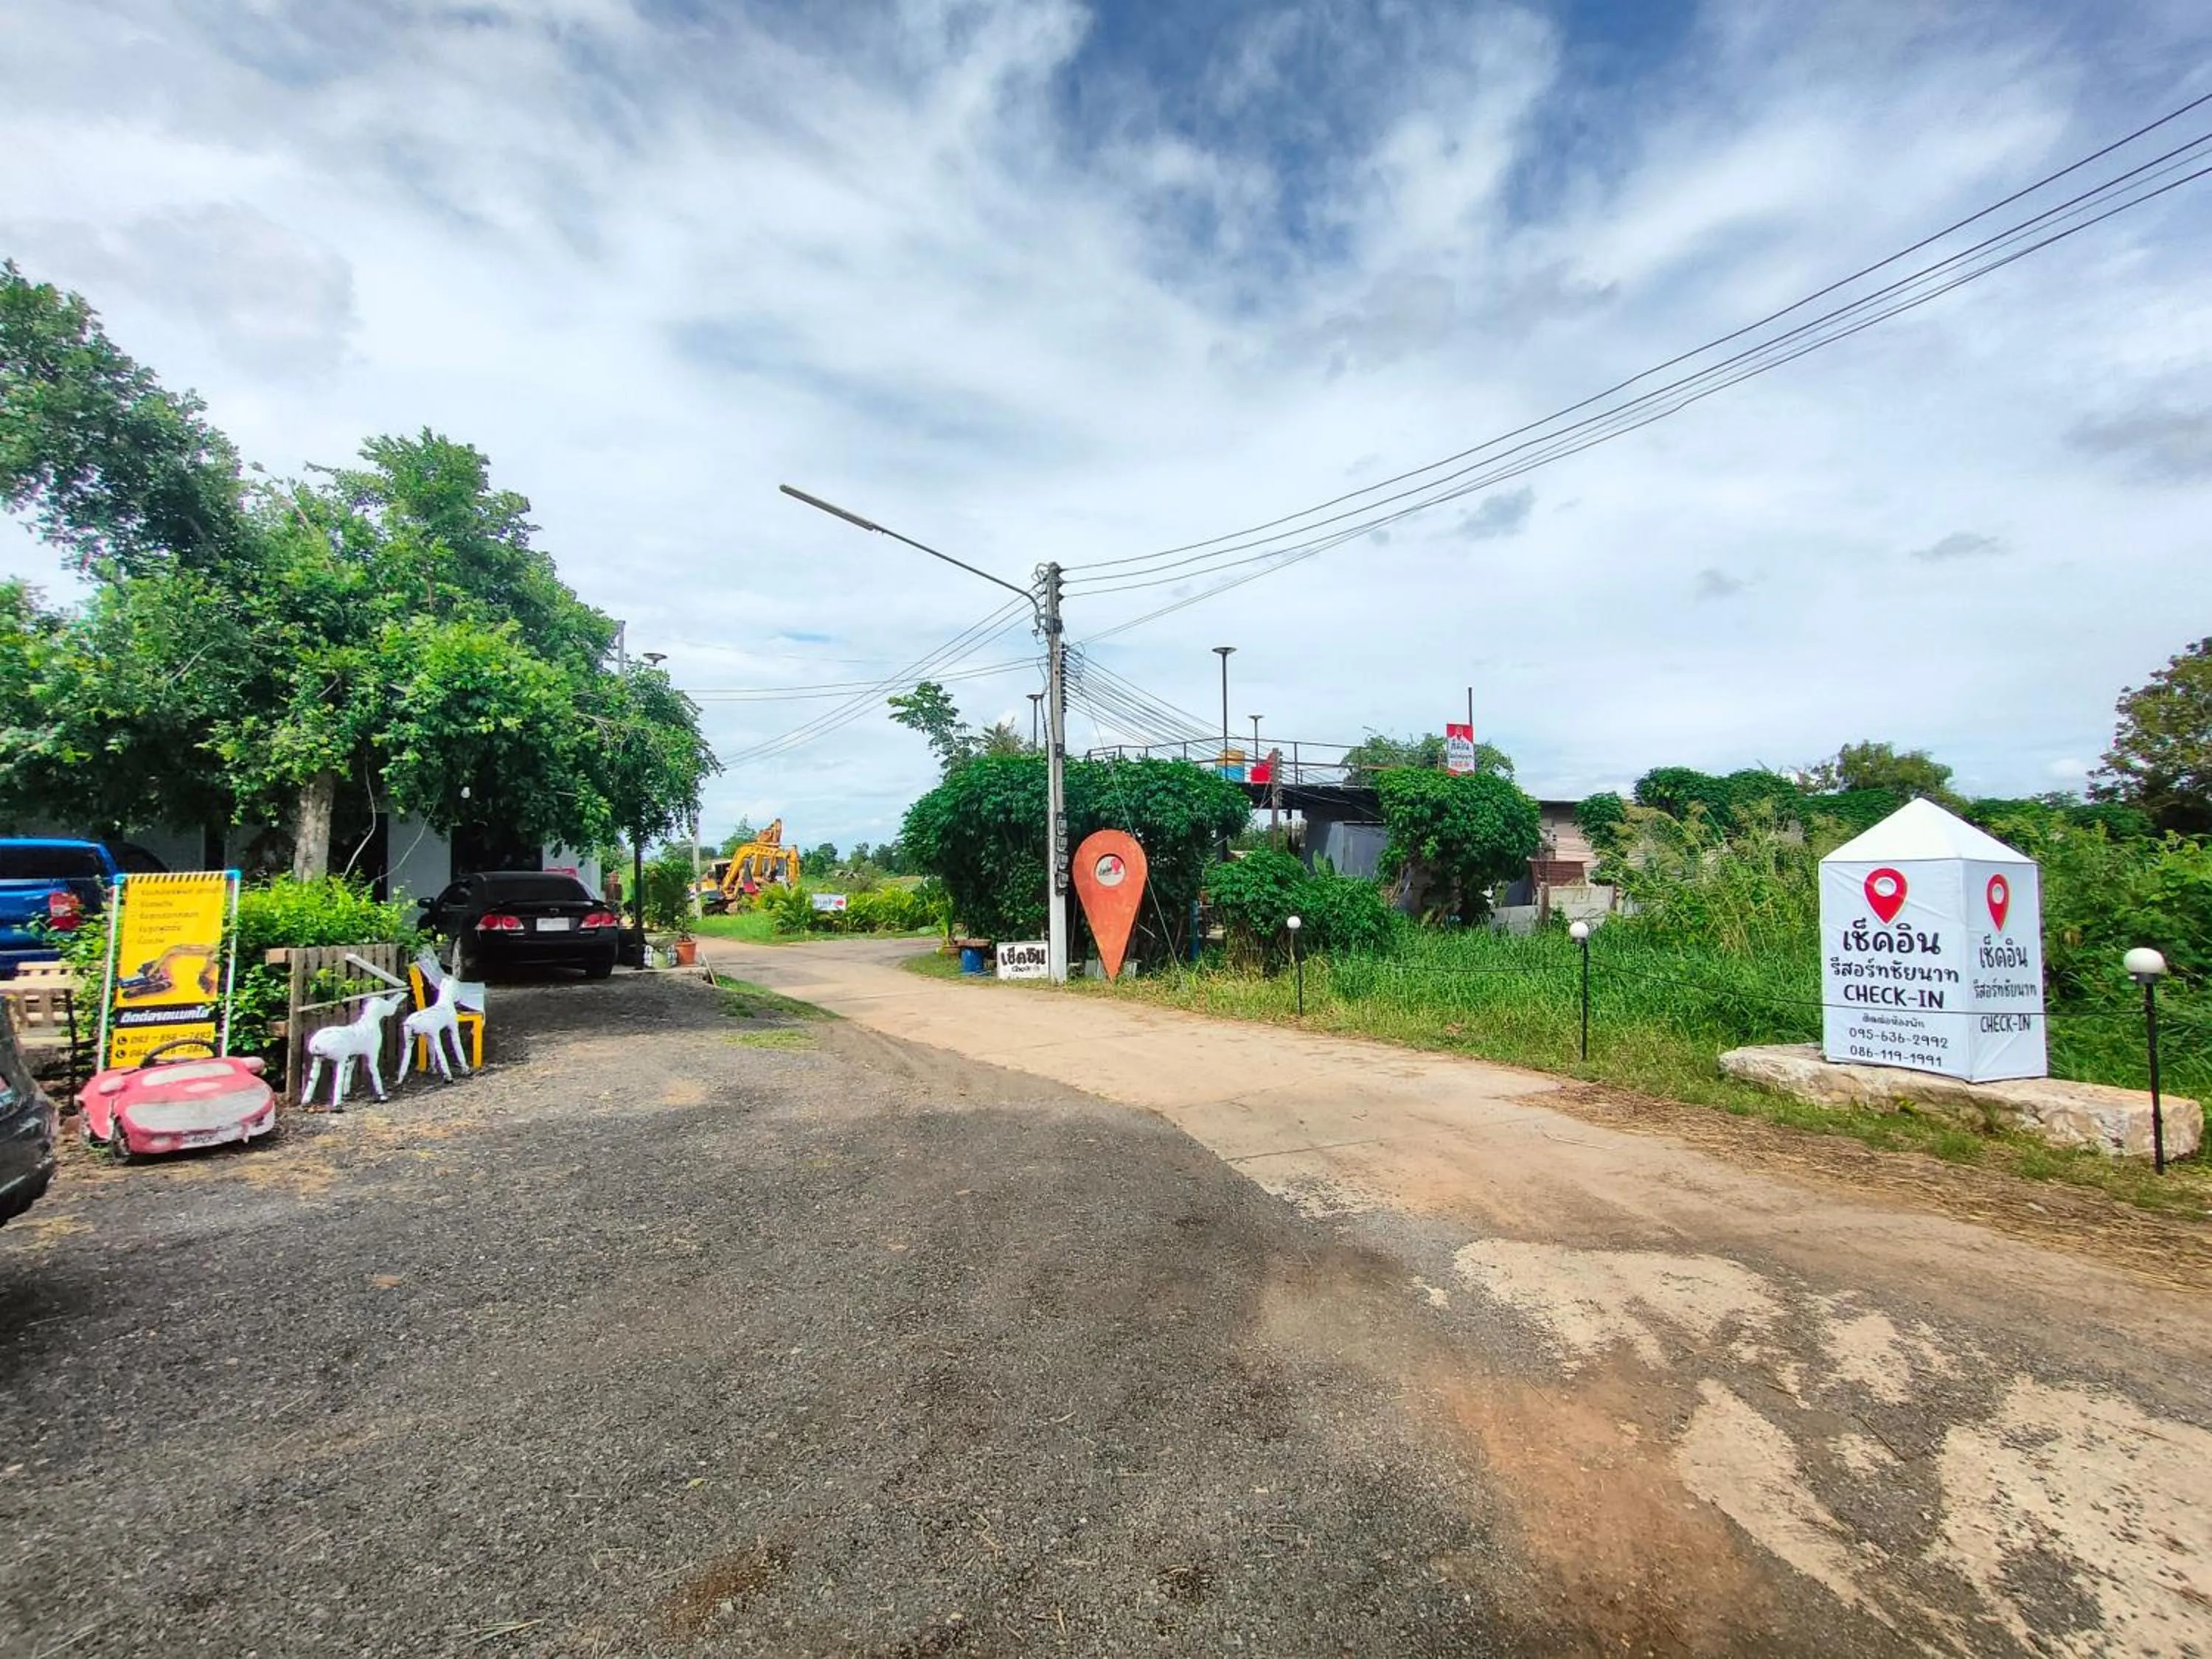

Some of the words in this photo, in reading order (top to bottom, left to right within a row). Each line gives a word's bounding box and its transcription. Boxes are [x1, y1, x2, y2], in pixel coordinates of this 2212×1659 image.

[1843, 917, 1941, 955] เช็คอิน
[1979, 933, 2028, 968] เช็คอิน
[1829, 956, 1960, 983] รีสอร์ทชัยนาท
[1843, 984, 1944, 1009] CHECK-IN
[1980, 1014, 2031, 1033] CHECK-IN
[1848, 1026, 1949, 1049] 095-636-2992
[1849, 1045, 1942, 1067] 086-119-1991
